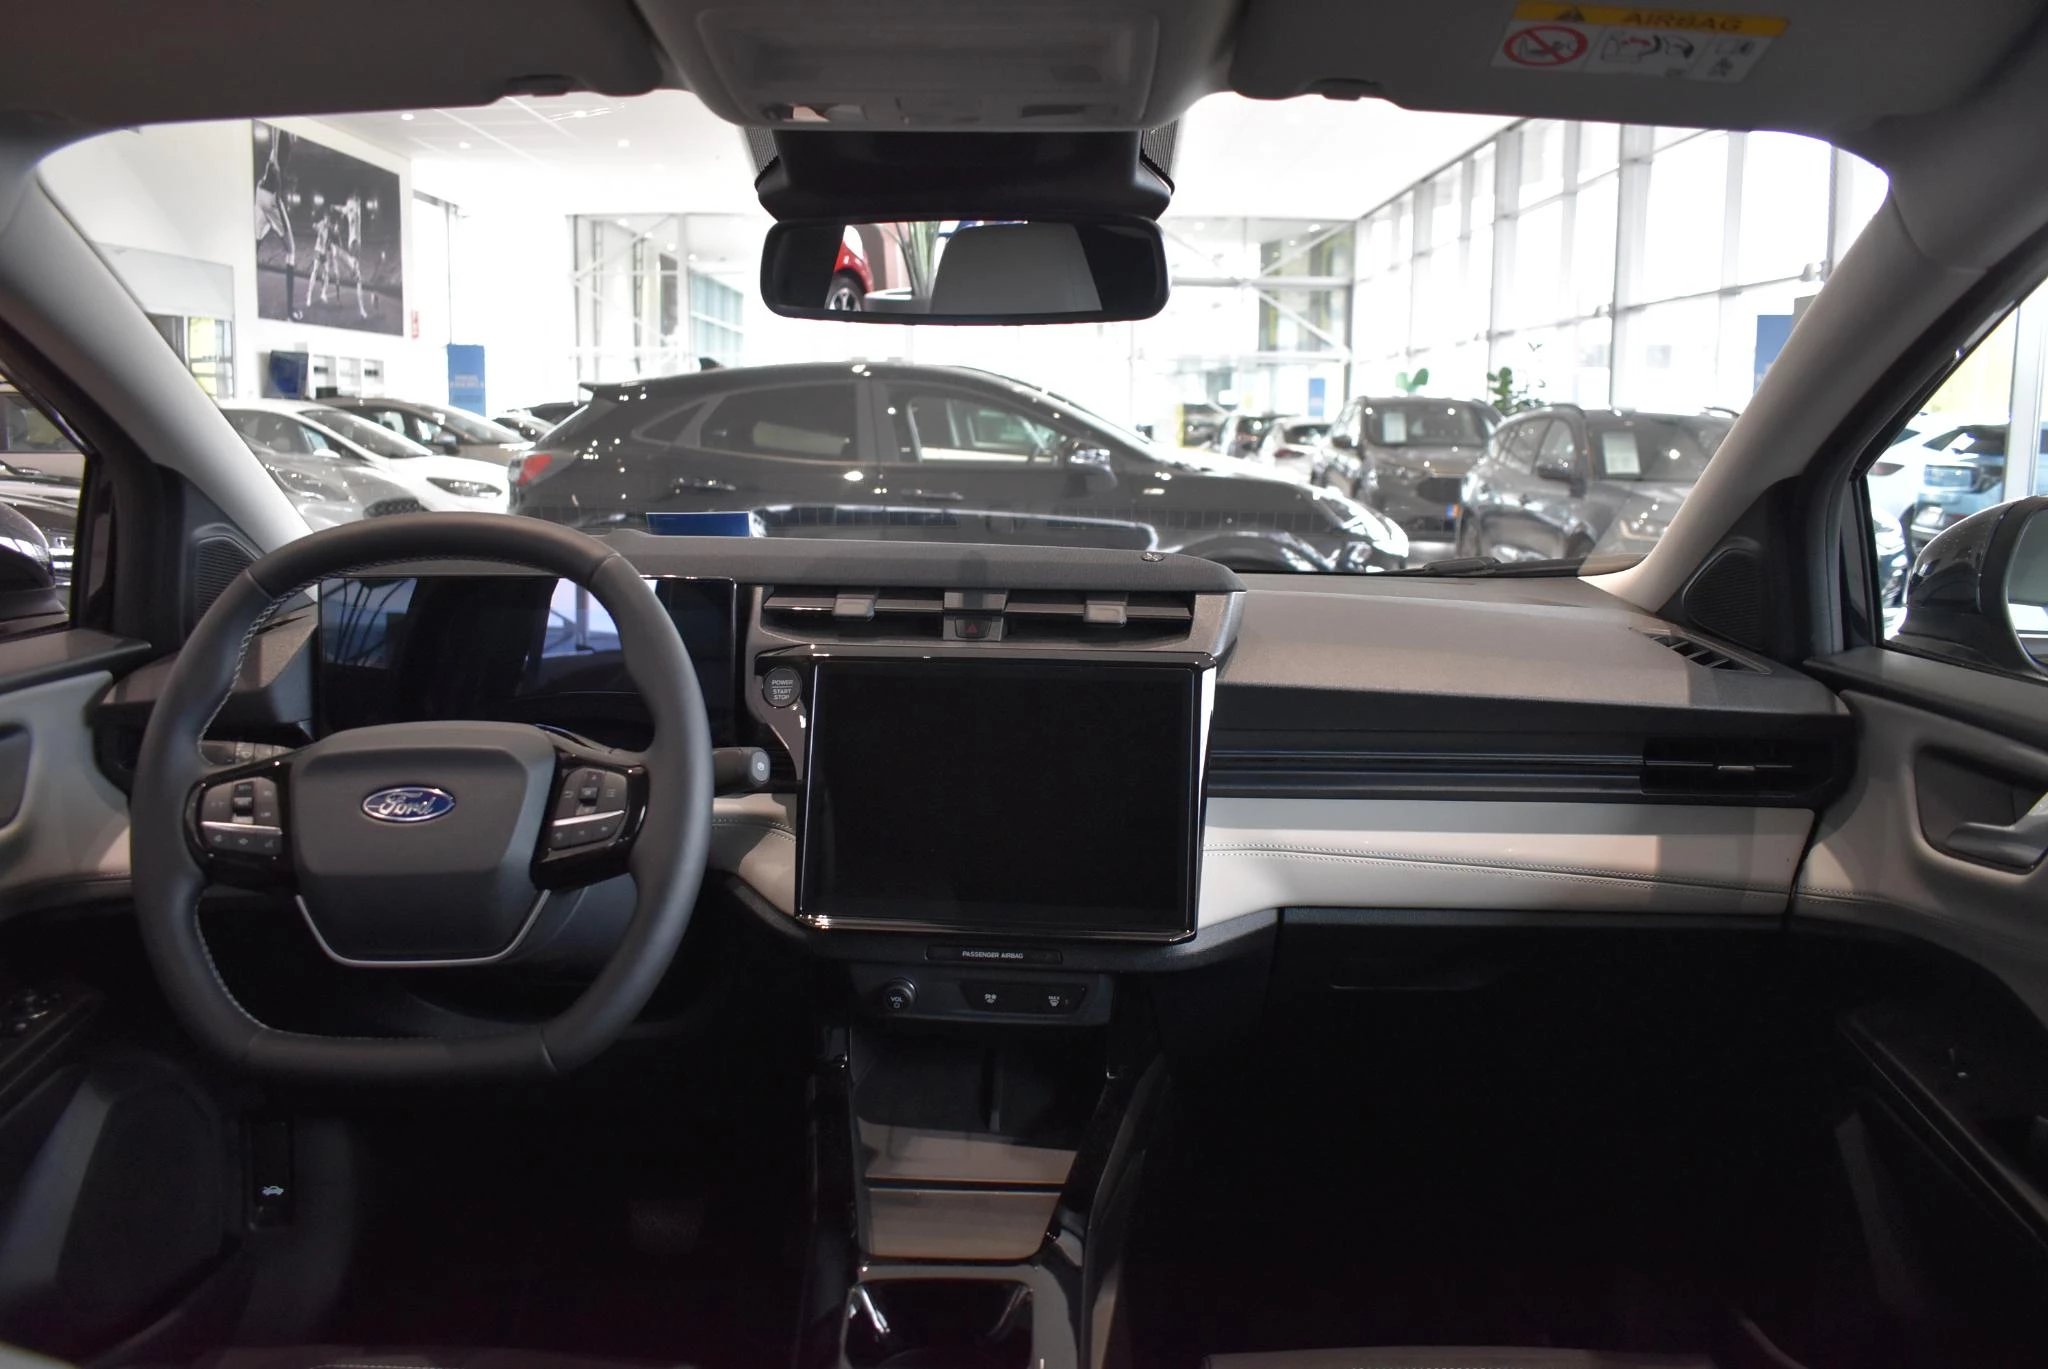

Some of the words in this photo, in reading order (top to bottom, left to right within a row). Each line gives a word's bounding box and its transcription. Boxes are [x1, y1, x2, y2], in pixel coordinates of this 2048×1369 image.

[1621, 12, 1743, 31] AIRBAG
[379, 791, 436, 815] Ford
[962, 950, 1000, 958] PASSENGER
[1001, 952, 1024, 960] AIRBAG
